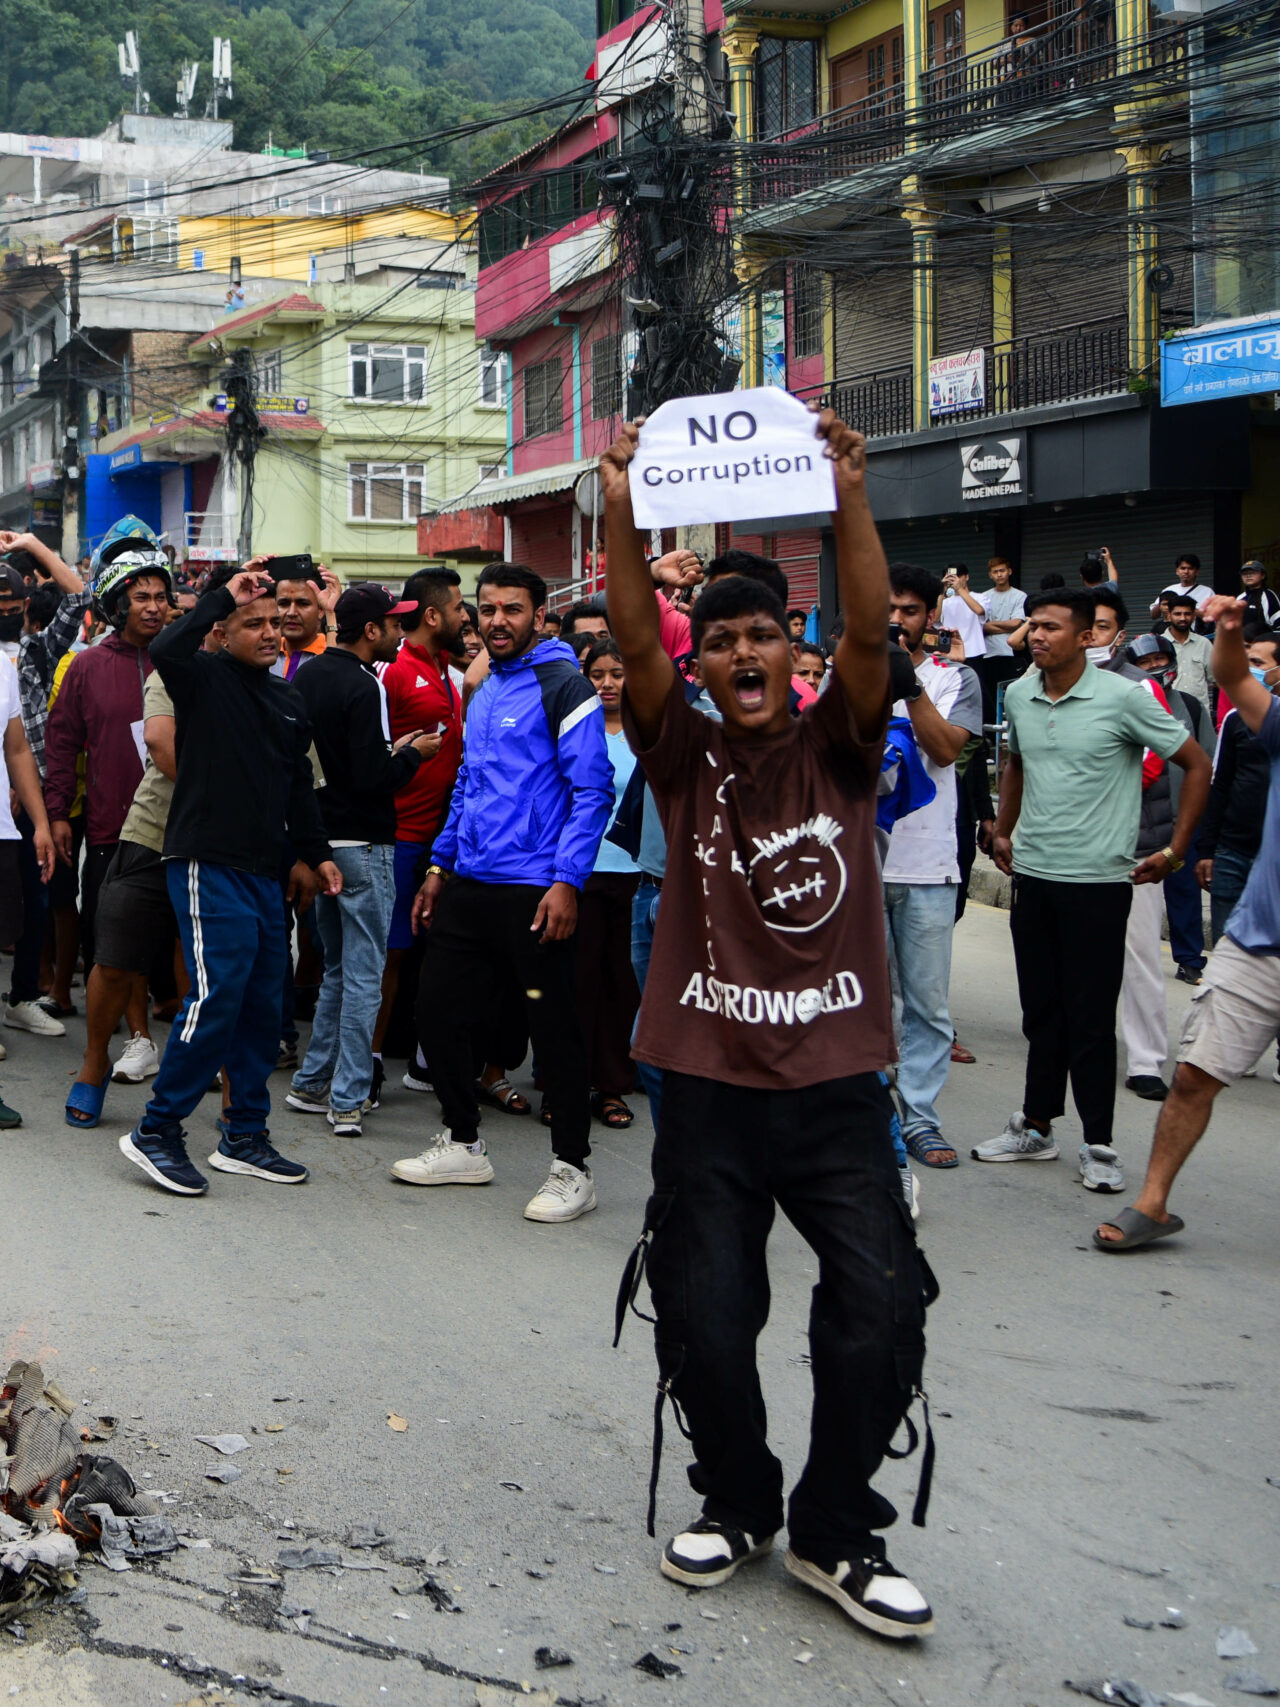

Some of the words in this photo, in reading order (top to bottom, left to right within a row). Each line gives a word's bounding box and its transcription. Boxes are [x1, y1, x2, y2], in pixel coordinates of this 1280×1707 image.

[688, 410, 757, 446] NO
[642, 454, 812, 487] Corruption
[969, 455, 1012, 472] Caliber
[962, 487, 984, 500] MADE
[984, 486, 994, 497] IN
[994, 482, 1022, 496] NEPAL
